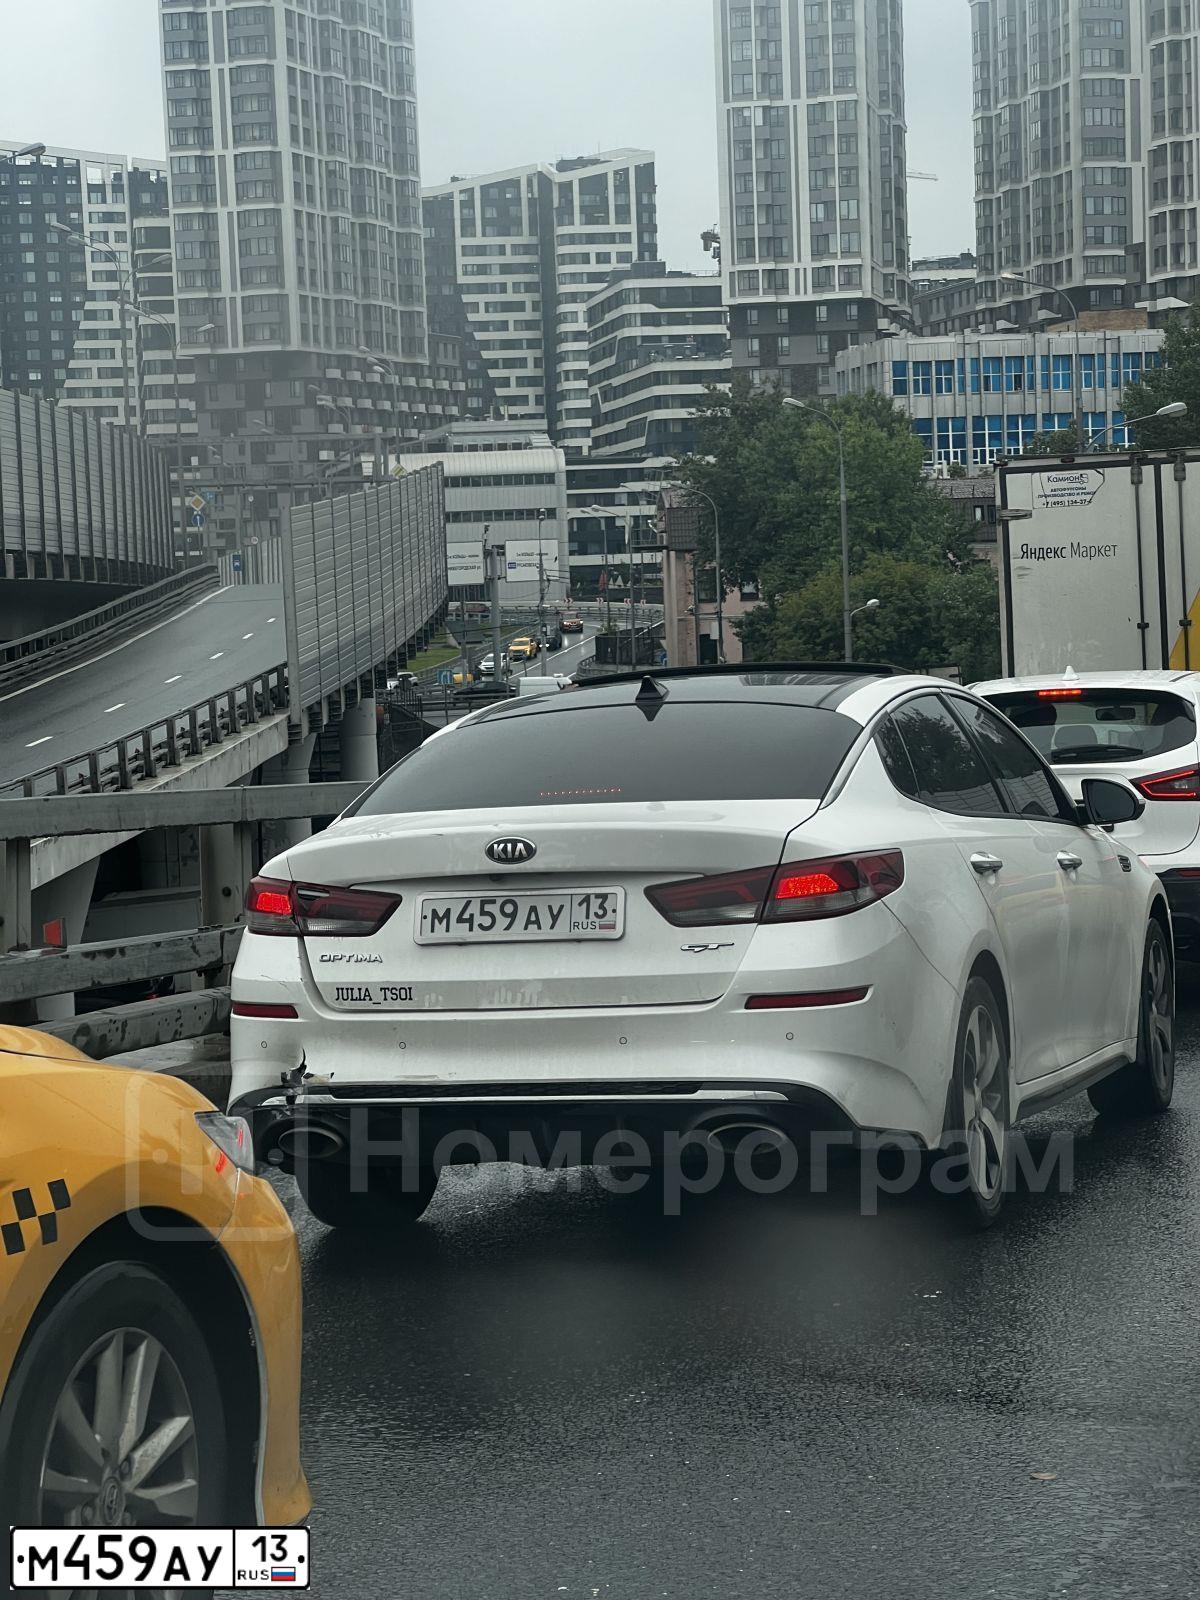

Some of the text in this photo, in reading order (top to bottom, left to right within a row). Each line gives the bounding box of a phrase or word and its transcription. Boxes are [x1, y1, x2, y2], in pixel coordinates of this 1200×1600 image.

[1047, 475, 1080, 483] Камион
[1020, 541, 1118, 561] Яндекс Маркет
[493, 842, 528, 859] KIA
[577, 894, 609, 920] 13
[573, 920, 597, 930] RUS
[319, 953, 384, 964] OPTIMA
[335, 986, 414, 1005] JULIA_TSOI
